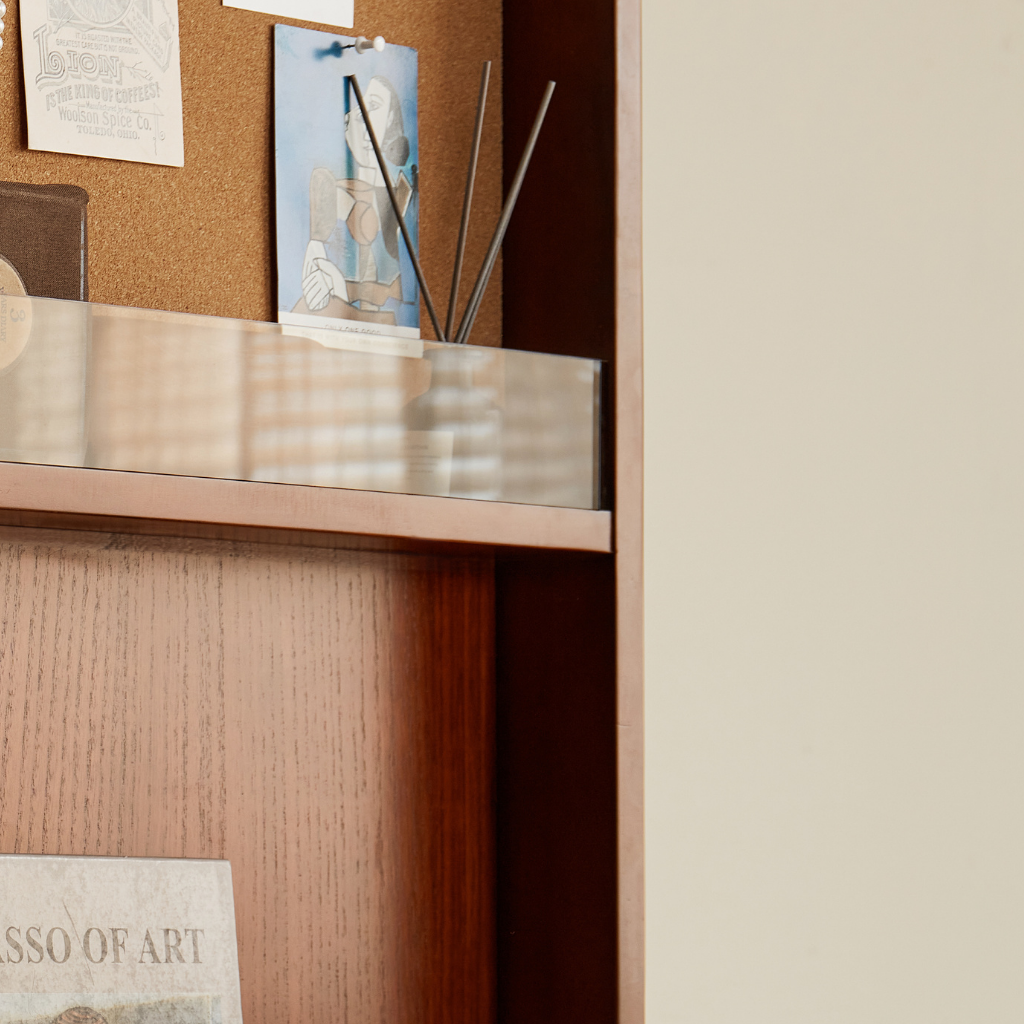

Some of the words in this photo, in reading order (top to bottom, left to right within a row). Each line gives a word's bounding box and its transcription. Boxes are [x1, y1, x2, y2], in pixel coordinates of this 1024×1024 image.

[32, 23, 122, 86] LION
[45, 92, 56, 112] IS
[56, 85, 74, 104] THE
[75, 83, 101, 100] KING
[101, 85, 115, 102] OF
[116, 81, 161, 104] COFFEES!
[58, 105, 99, 125] Woolson
[102, 111, 133, 130] Spice
[137, 113, 152, 131] Co.
[0, 315, 7, 343] DIARY
[82, 926, 129, 964] OF
[138, 926, 206, 964] ART
